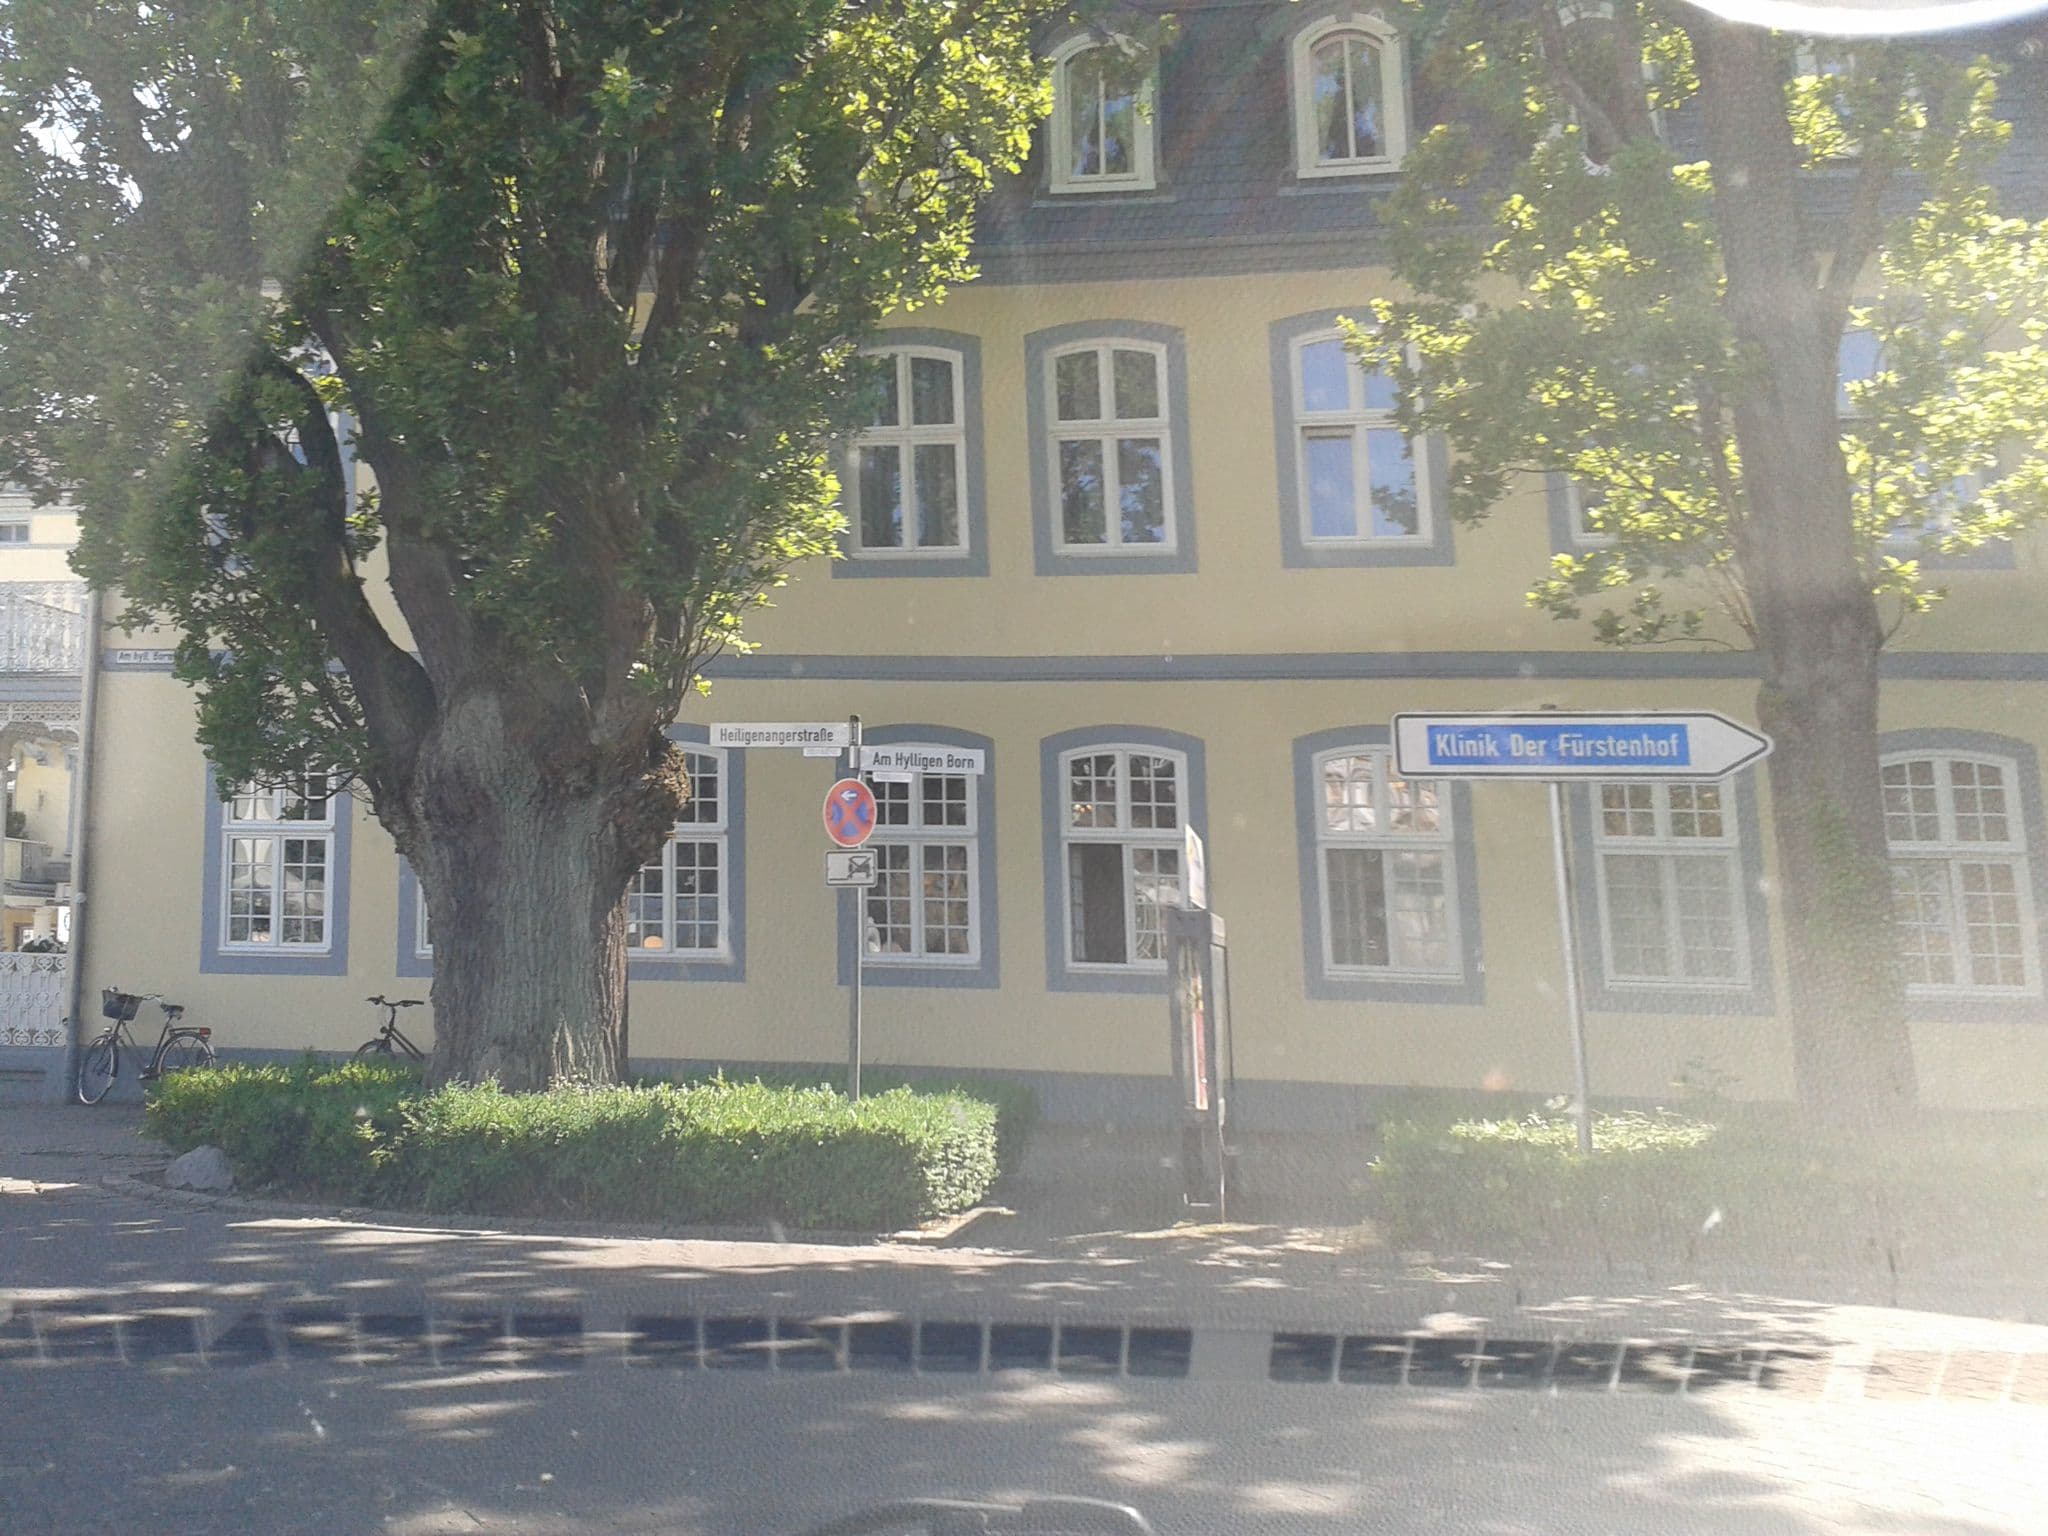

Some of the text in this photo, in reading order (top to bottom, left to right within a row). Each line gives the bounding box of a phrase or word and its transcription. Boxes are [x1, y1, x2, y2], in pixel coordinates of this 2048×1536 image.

[720, 728, 834, 745] Heiligenangerstraße
[1436, 733, 1679, 757] Klinik Der Fürstenhof
[873, 753, 975, 771] Am Hylligen Born
